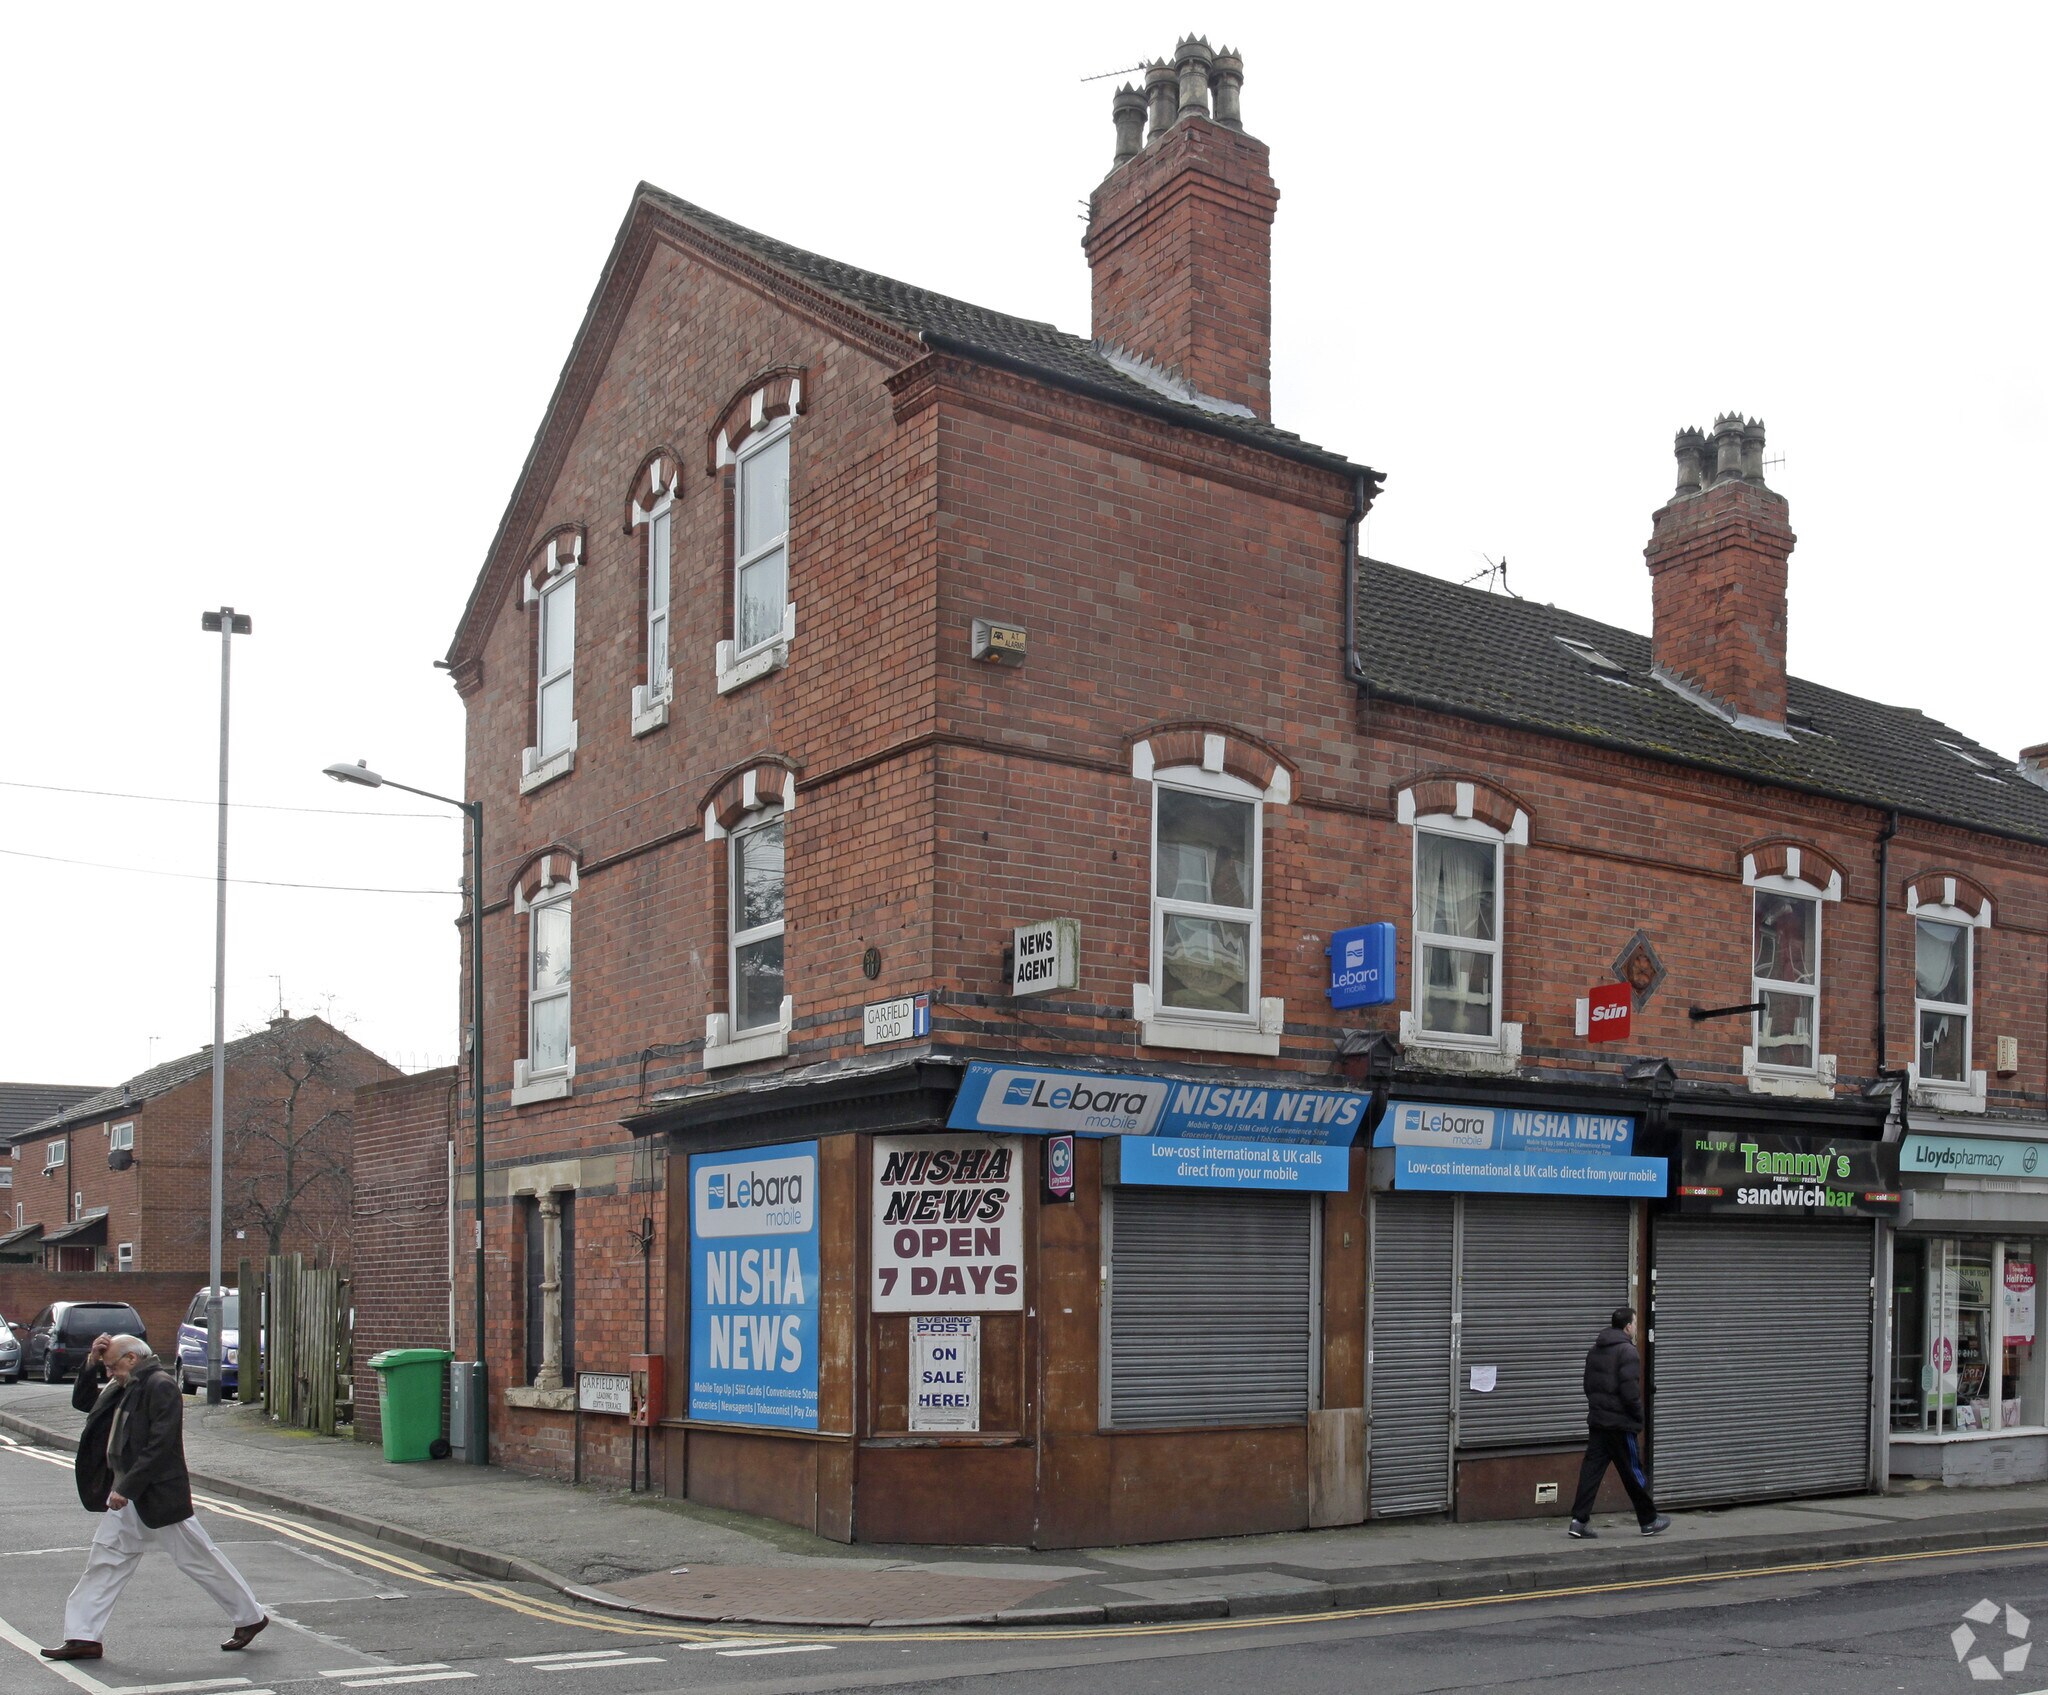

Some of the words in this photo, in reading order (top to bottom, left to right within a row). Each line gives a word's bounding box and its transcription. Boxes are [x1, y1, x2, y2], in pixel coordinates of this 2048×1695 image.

[1020, 931, 1053, 956] NEWS
[1017, 957, 1055, 983] AGENT
[1332, 967, 1378, 988] Lebara
[1343, 983, 1367, 995] mobile
[868, 1002, 910, 1024] GARFIELD
[1591, 1005, 1628, 1022] Sun
[876, 1022, 901, 1040] ROAD
[972, 1066, 993, 1074] 97-99
[1032, 1079, 1147, 1115] Lebara
[1172, 1085, 1264, 1120] NISHA
[1274, 1094, 1361, 1126] NEWS
[1085, 1115, 1138, 1130] mobile
[1187, 1120, 1211, 1130] Mobile
[1211, 1122, 1223, 1131] Top
[1223, 1123, 1233, 1132] Up
[1238, 1124, 1251, 1132] SIM
[1251, 1125, 1269, 1133] Cards
[1273, 1126, 1312, 1136] Convenience
[1313, 1128, 1329, 1136] Store
[1421, 1110, 1484, 1134] Lebara
[1512, 1112, 1571, 1139] NISHA
[1574, 1117, 1628, 1142] NEWS
[1181, 1130, 1212, 1140] Groceries
[1452, 1134, 1482, 1146] mobile
[1151, 1143, 1200, 1160] Low-cost
[1202, 1147, 1270, 1163] international
[1272, 1149, 1281, 1162] &
[1282, 1149, 1297, 1164] UK
[1299, 1149, 1322, 1165] calls
[1695, 1140, 1714, 1151] FILL
[1716, 1141, 1727, 1152] UP
[880, 1148, 1013, 1185] NISHA
[1916, 1145, 2004, 1169] Lloydspharmacy
[1177, 1162, 1208, 1178] direct
[1211, 1164, 1235, 1180] from
[1237, 1168, 1260, 1183] your
[1262, 1166, 1298, 1181] mobile
[1408, 1160, 1450, 1175] Low-cost
[1452, 1161, 1512, 1177] international
[1514, 1164, 1521, 1177] &
[1523, 1164, 1537, 1178] UK
[1538, 1165, 1558, 1179] calls
[1560, 1166, 1585, 1180] direct
[1587, 1167, 1606, 1181] from
[1608, 1170, 1627, 1184] your
[1629, 1168, 1657, 1182] mobile
[726, 1171, 802, 1209] Lebara
[1737, 1184, 1854, 1208] sandwichbar
[883, 1187, 1010, 1225] NEWS
[766, 1208, 802, 1226] mobile
[893, 1228, 1001, 1259] OPEN
[706, 1248, 805, 1305] NISHA
[879, 1267, 899, 1297] 7
[911, 1264, 1018, 1296] DAYS
[2006, 1274, 2020, 1283] Half
[2020, 1274, 2034, 1283] Price
[917, 1316, 972, 1324] EVENING
[917, 1323, 971, 1333] POST
[709, 1315, 802, 1371] NEWS
[932, 1348, 957, 1361] ON
[582, 1376, 613, 1390] GARFIELD
[616, 1379, 630, 1392] ROA
[923, 1371, 966, 1384] SALE
[694, 1381, 713, 1393] Mobile
[713, 1383, 723, 1396] Top
[723, 1384, 732, 1396] Up
[746, 1385, 762, 1396] Cards
[766, 1386, 801, 1398] Convenience
[802, 1388, 818, 1400] Store
[919, 1394, 970, 1407] HERE!
[692, 1399, 718, 1410] Groceries
[721, 1401, 753, 1414] Newsagents
[757, 1402, 790, 1416] Tobacconist
[793, 1406, 804, 1419] Pay
